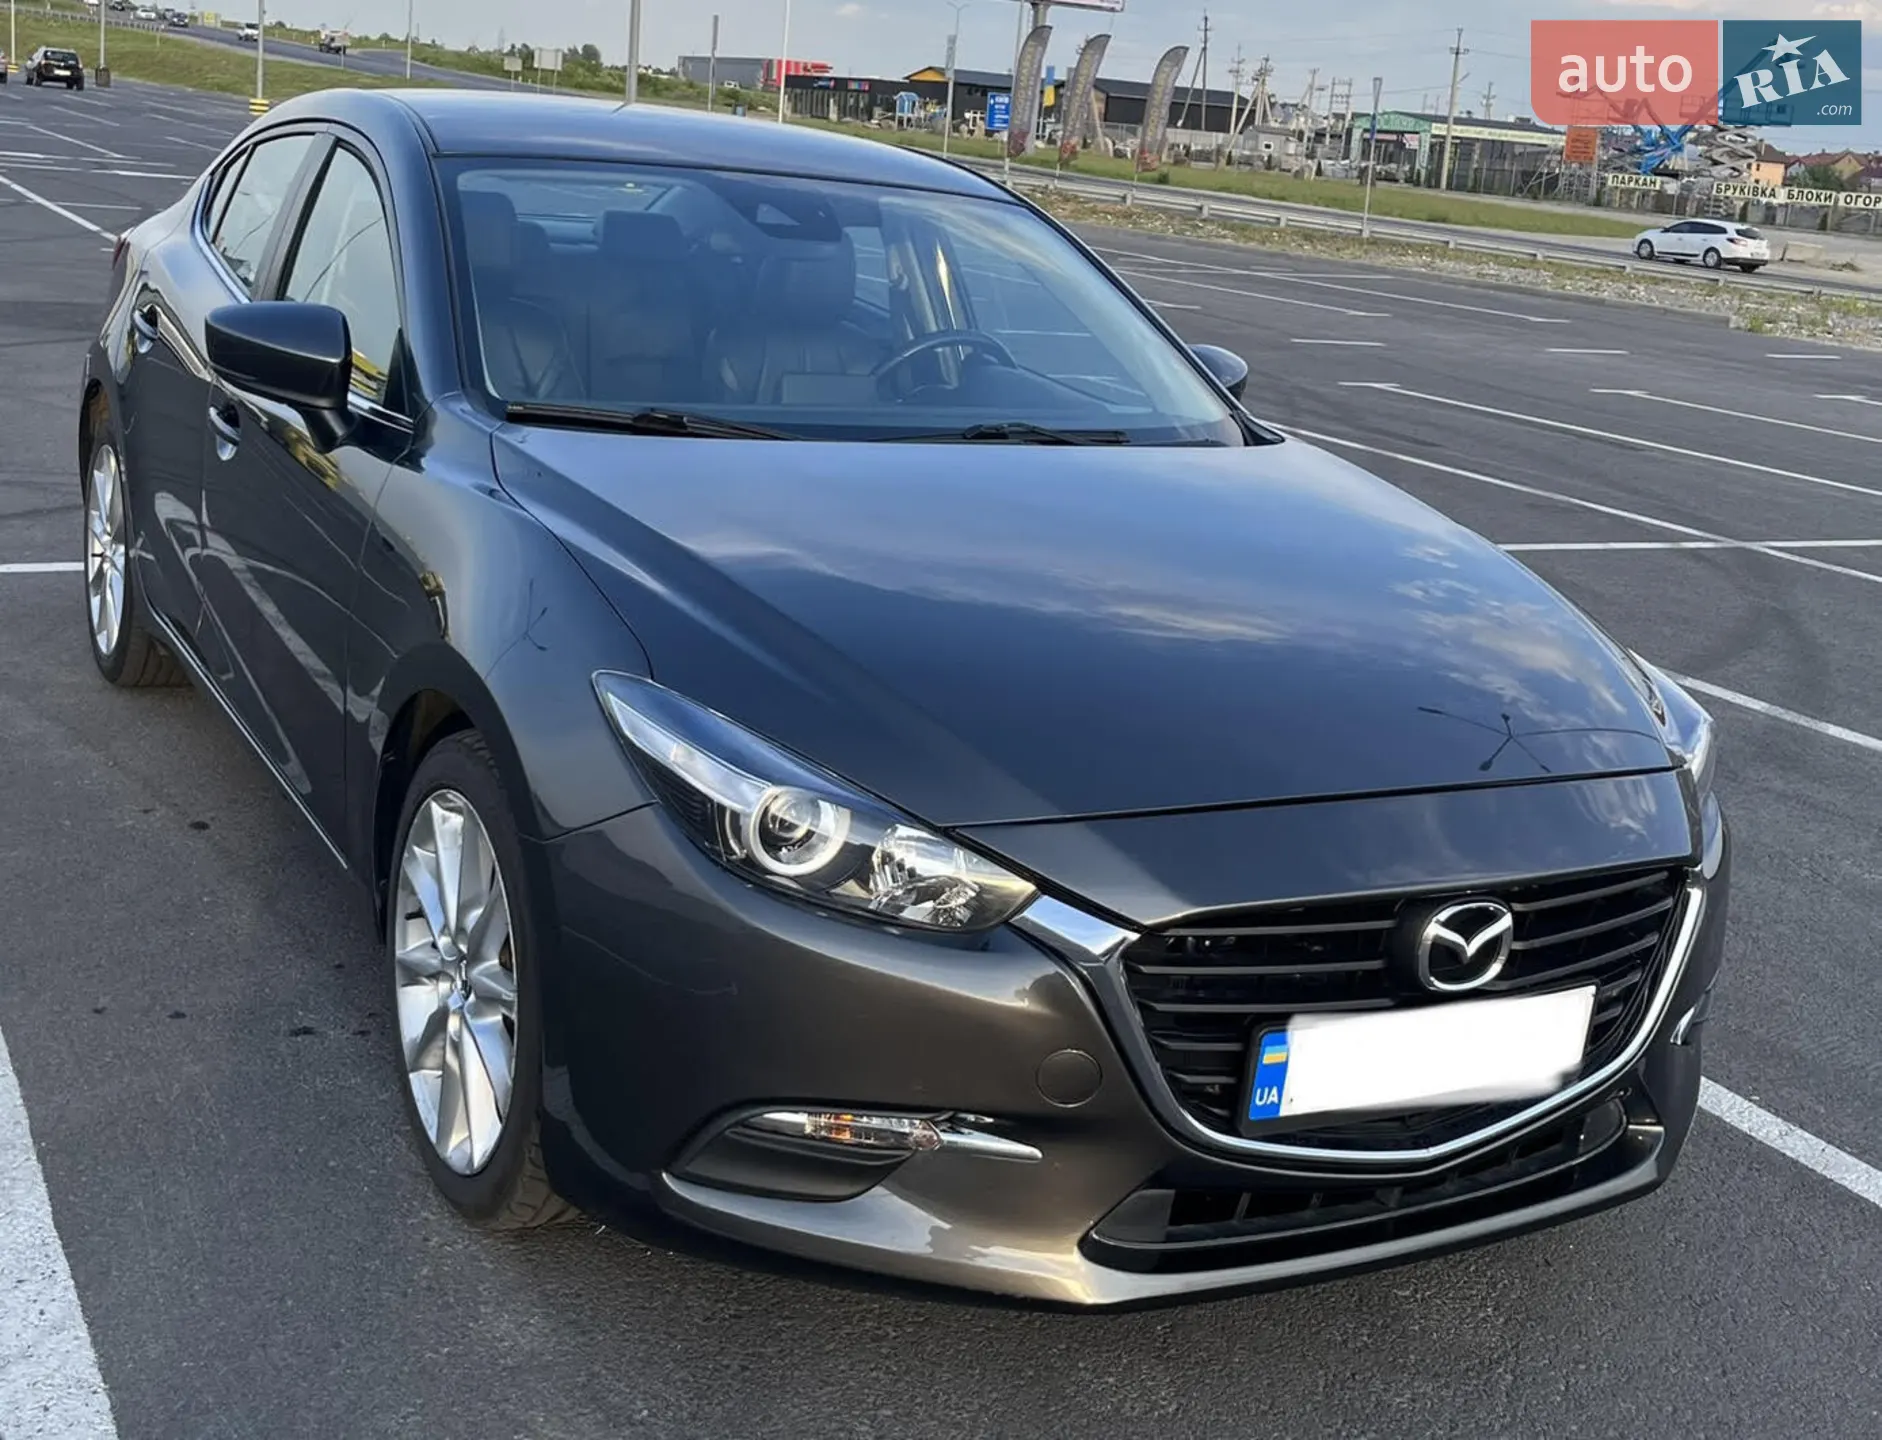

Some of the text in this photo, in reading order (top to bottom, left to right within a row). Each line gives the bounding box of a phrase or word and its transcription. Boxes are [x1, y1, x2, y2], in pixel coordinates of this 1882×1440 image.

[1611, 174, 1658, 189] ПАРКАН
[1715, 182, 1882, 207] БРУКІВКА БЛОКИ ОГОР
[1255, 1085, 1280, 1106] UA
